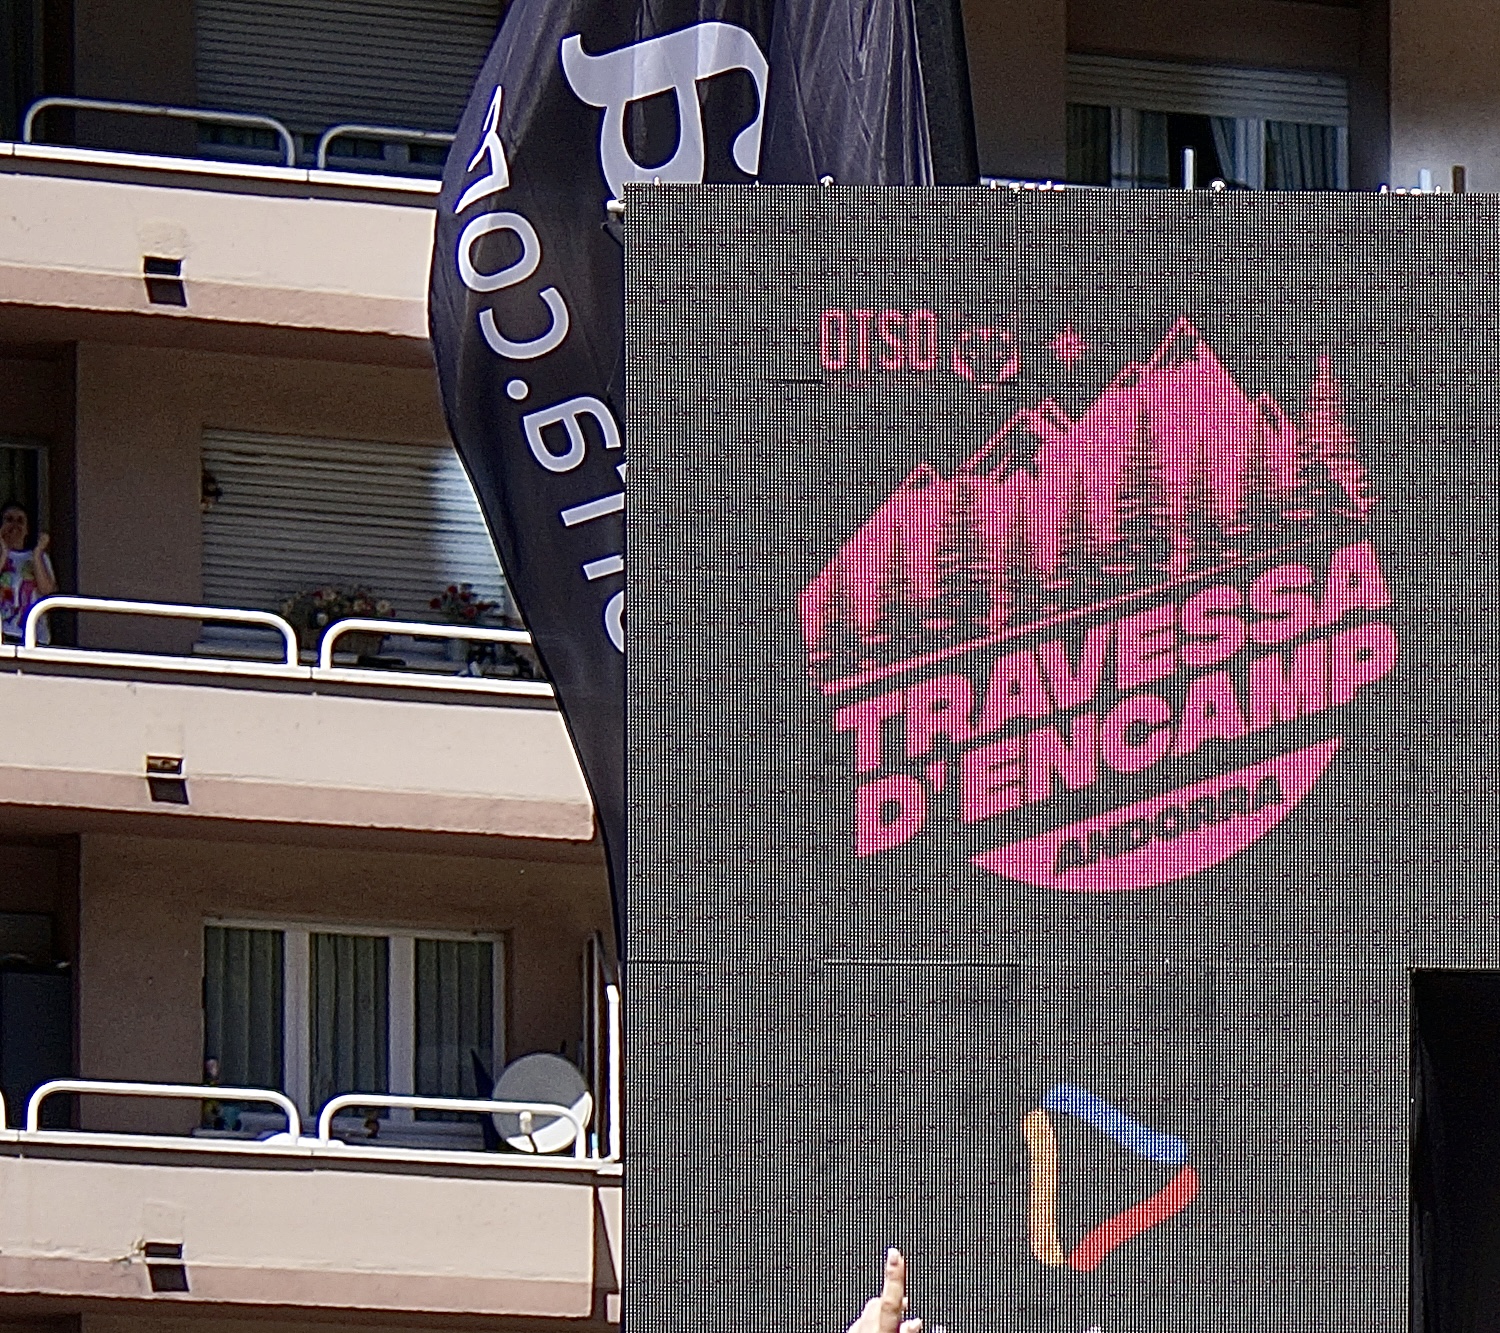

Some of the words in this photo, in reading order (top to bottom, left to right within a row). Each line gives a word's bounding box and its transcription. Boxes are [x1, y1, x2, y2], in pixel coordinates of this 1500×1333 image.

[820, 309, 938, 370] OTSO
[831, 539, 1391, 772] TRAVESSA
[855, 621, 1399, 858] D'ENCAMP
